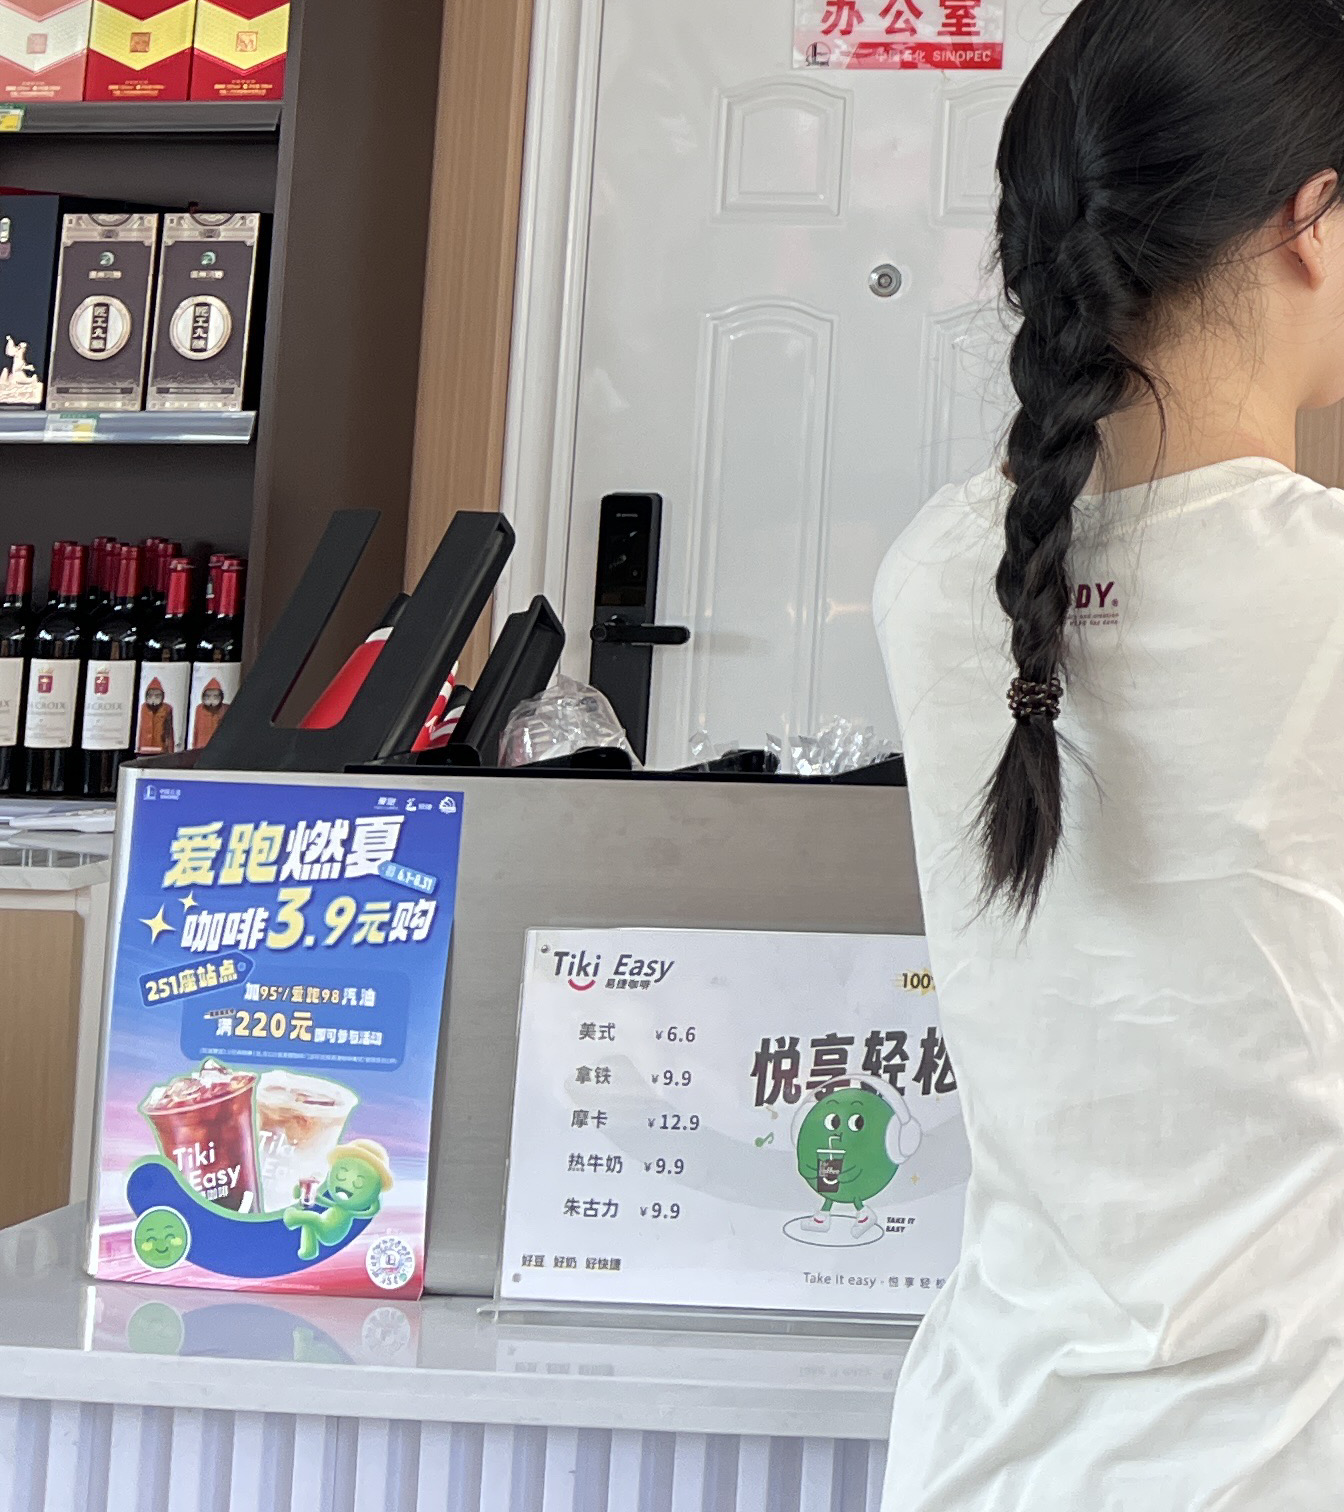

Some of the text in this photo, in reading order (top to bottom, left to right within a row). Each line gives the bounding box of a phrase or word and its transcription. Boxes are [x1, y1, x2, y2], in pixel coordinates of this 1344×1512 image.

[933, 48, 992, 62] SINOPEC
[161, 815, 405, 888] 爱跑燃夏
[180, 887, 437, 953] 咖啡3.9元购
[553, 950, 675, 984] Tiki Easy
[145, 959, 238, 1002] 251座站点
[902, 972, 936, 991] 100
[579, 1022, 696, 1043] 美式 ¥6.6
[575, 1065, 692, 1087] 拿铁 ¥9.9
[750, 1027, 958, 1107] 悦享轻松
[571, 1110, 700, 1131] 摩卡 ¥12.9
[173, 1141, 216, 1172] Tiki
[567, 1154, 685, 1176] 热牛奶 ¥9.9
[189, 1164, 241, 1191] Easy
[563, 1198, 681, 1221] 朱古力 ¥9.9
[521, 1254, 622, 1271] 好豆 好奶 好快捷
[804, 1272, 831, 1285] Take
[848, 1275, 877, 1289] easy
